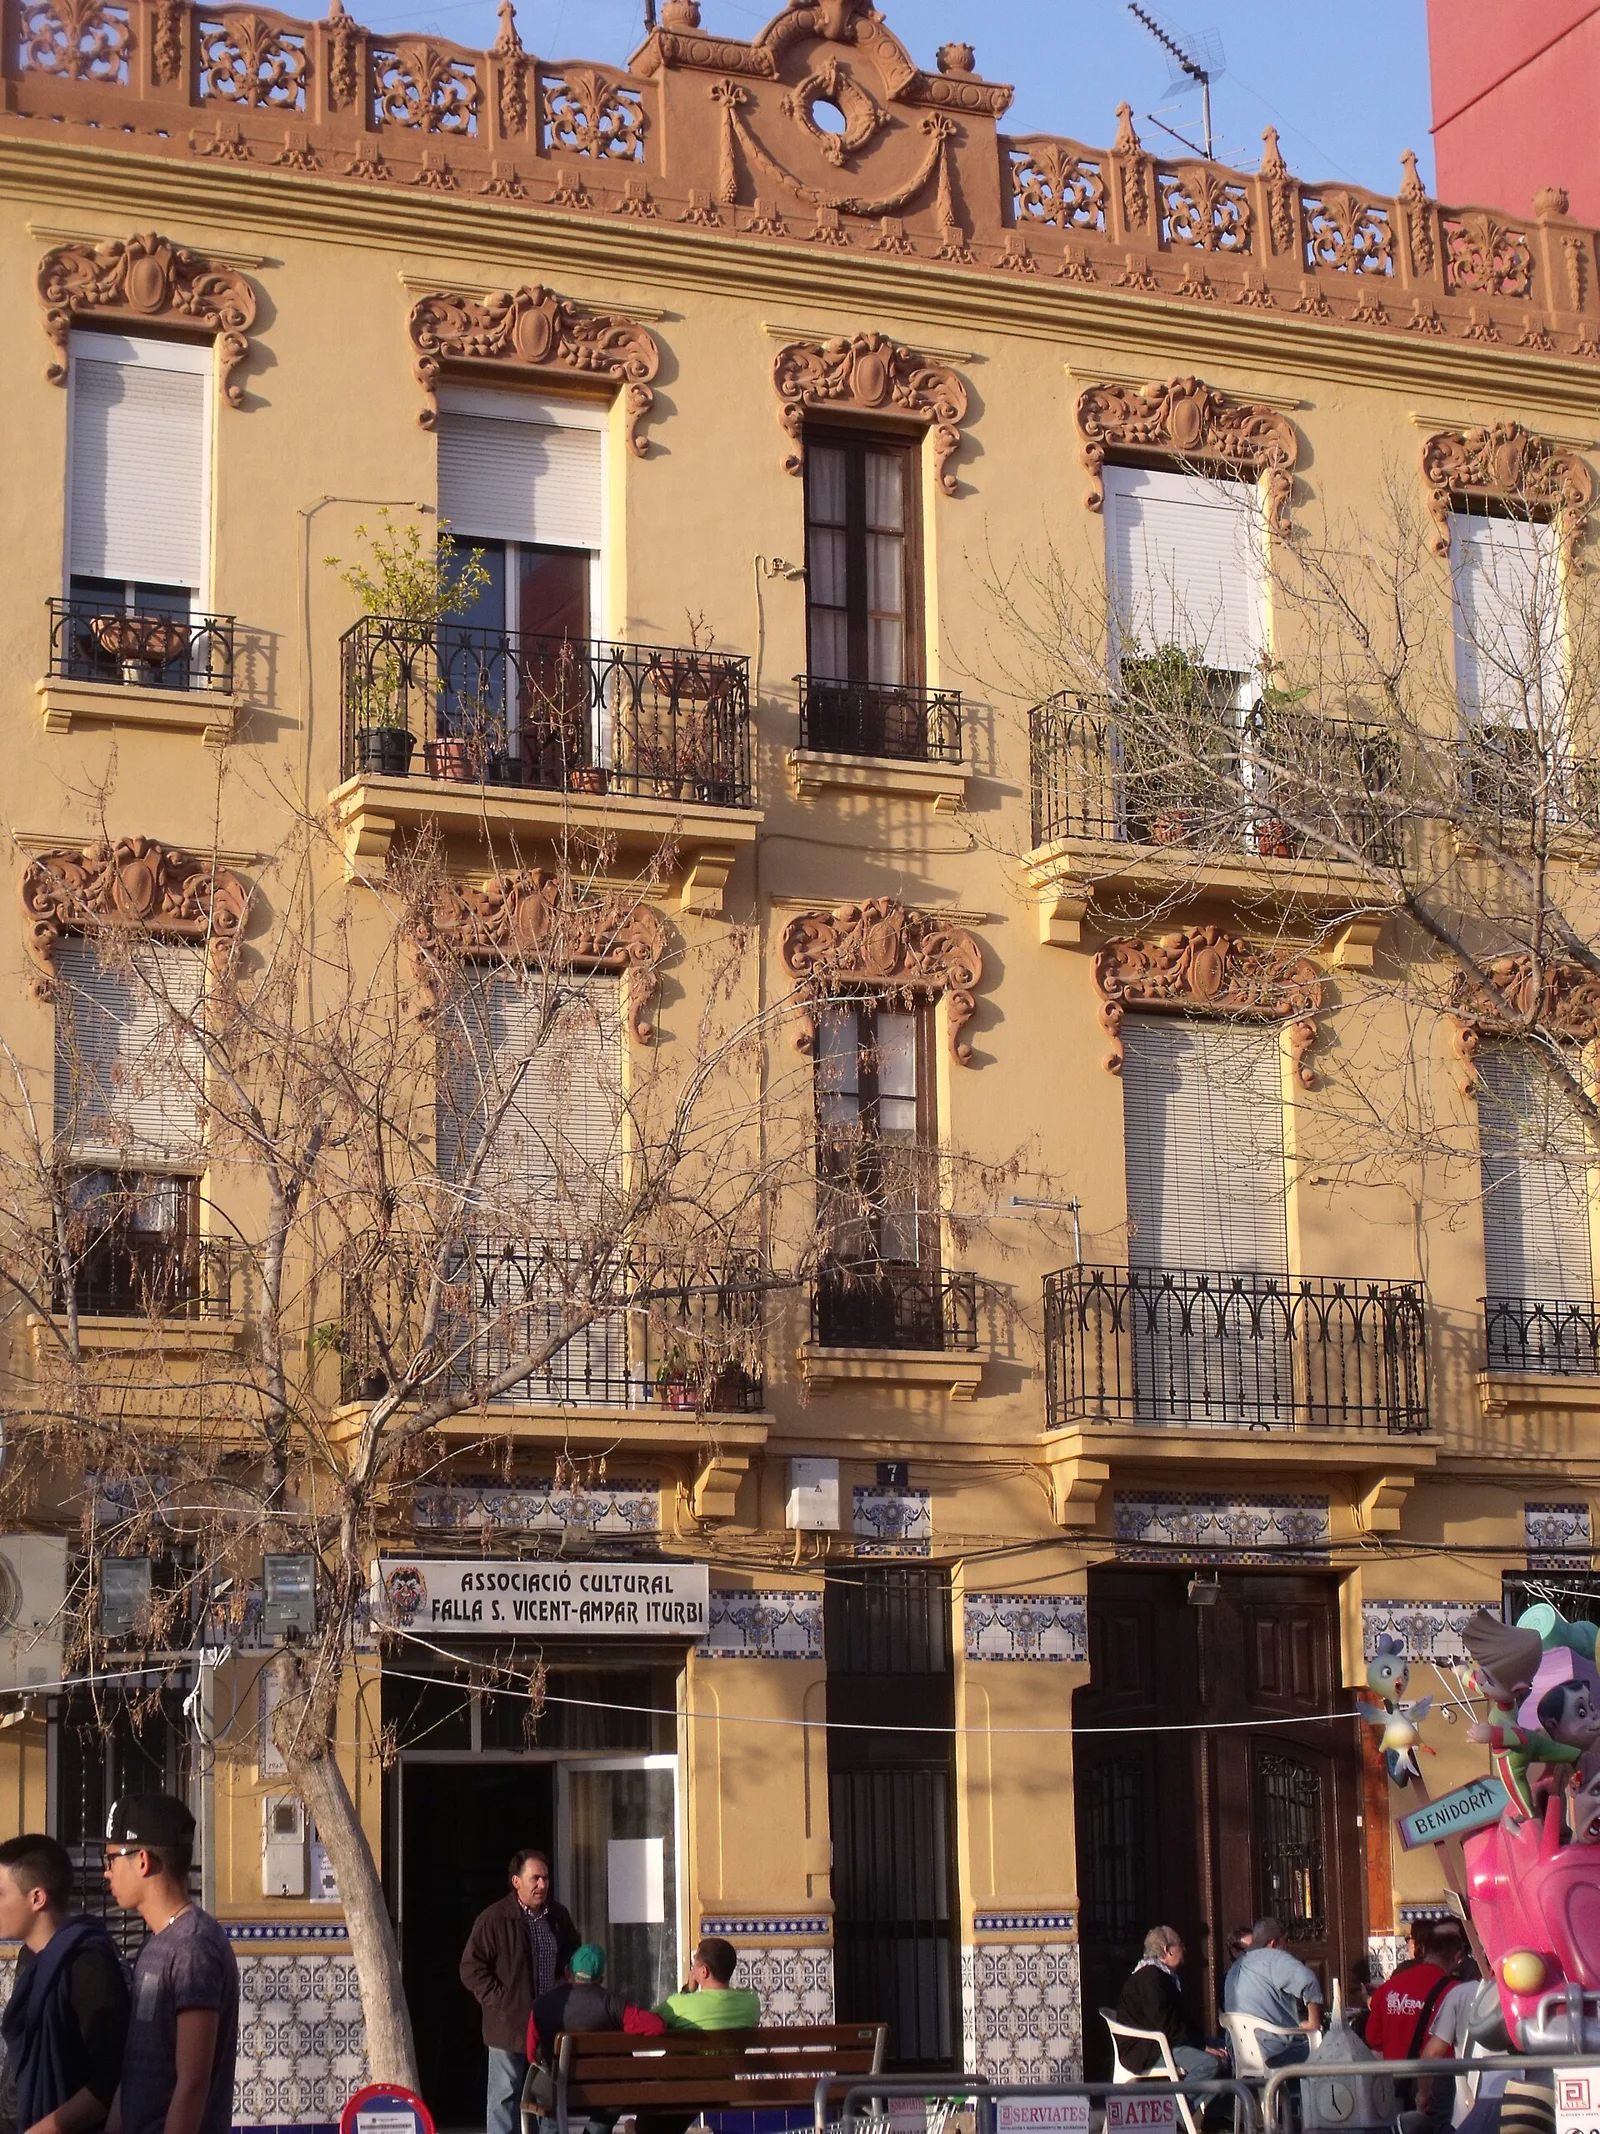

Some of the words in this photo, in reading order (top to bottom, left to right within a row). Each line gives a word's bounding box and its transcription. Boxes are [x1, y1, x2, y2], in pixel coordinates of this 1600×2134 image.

[887, 1463, 898, 1482] 7
[461, 1569, 572, 1593] ASSOCIACIÓ
[580, 1574, 674, 1595] CULTURAL
[432, 1598, 483, 1623] FALLA
[491, 1600, 506, 1622] S.
[513, 1600, 639, 1625] VICENT-AMPAR
[647, 1601, 704, 1624] ITURBI
[1013, 2105, 1087, 2123] SERVIATES
[1125, 2100, 1175, 2125] ATES
